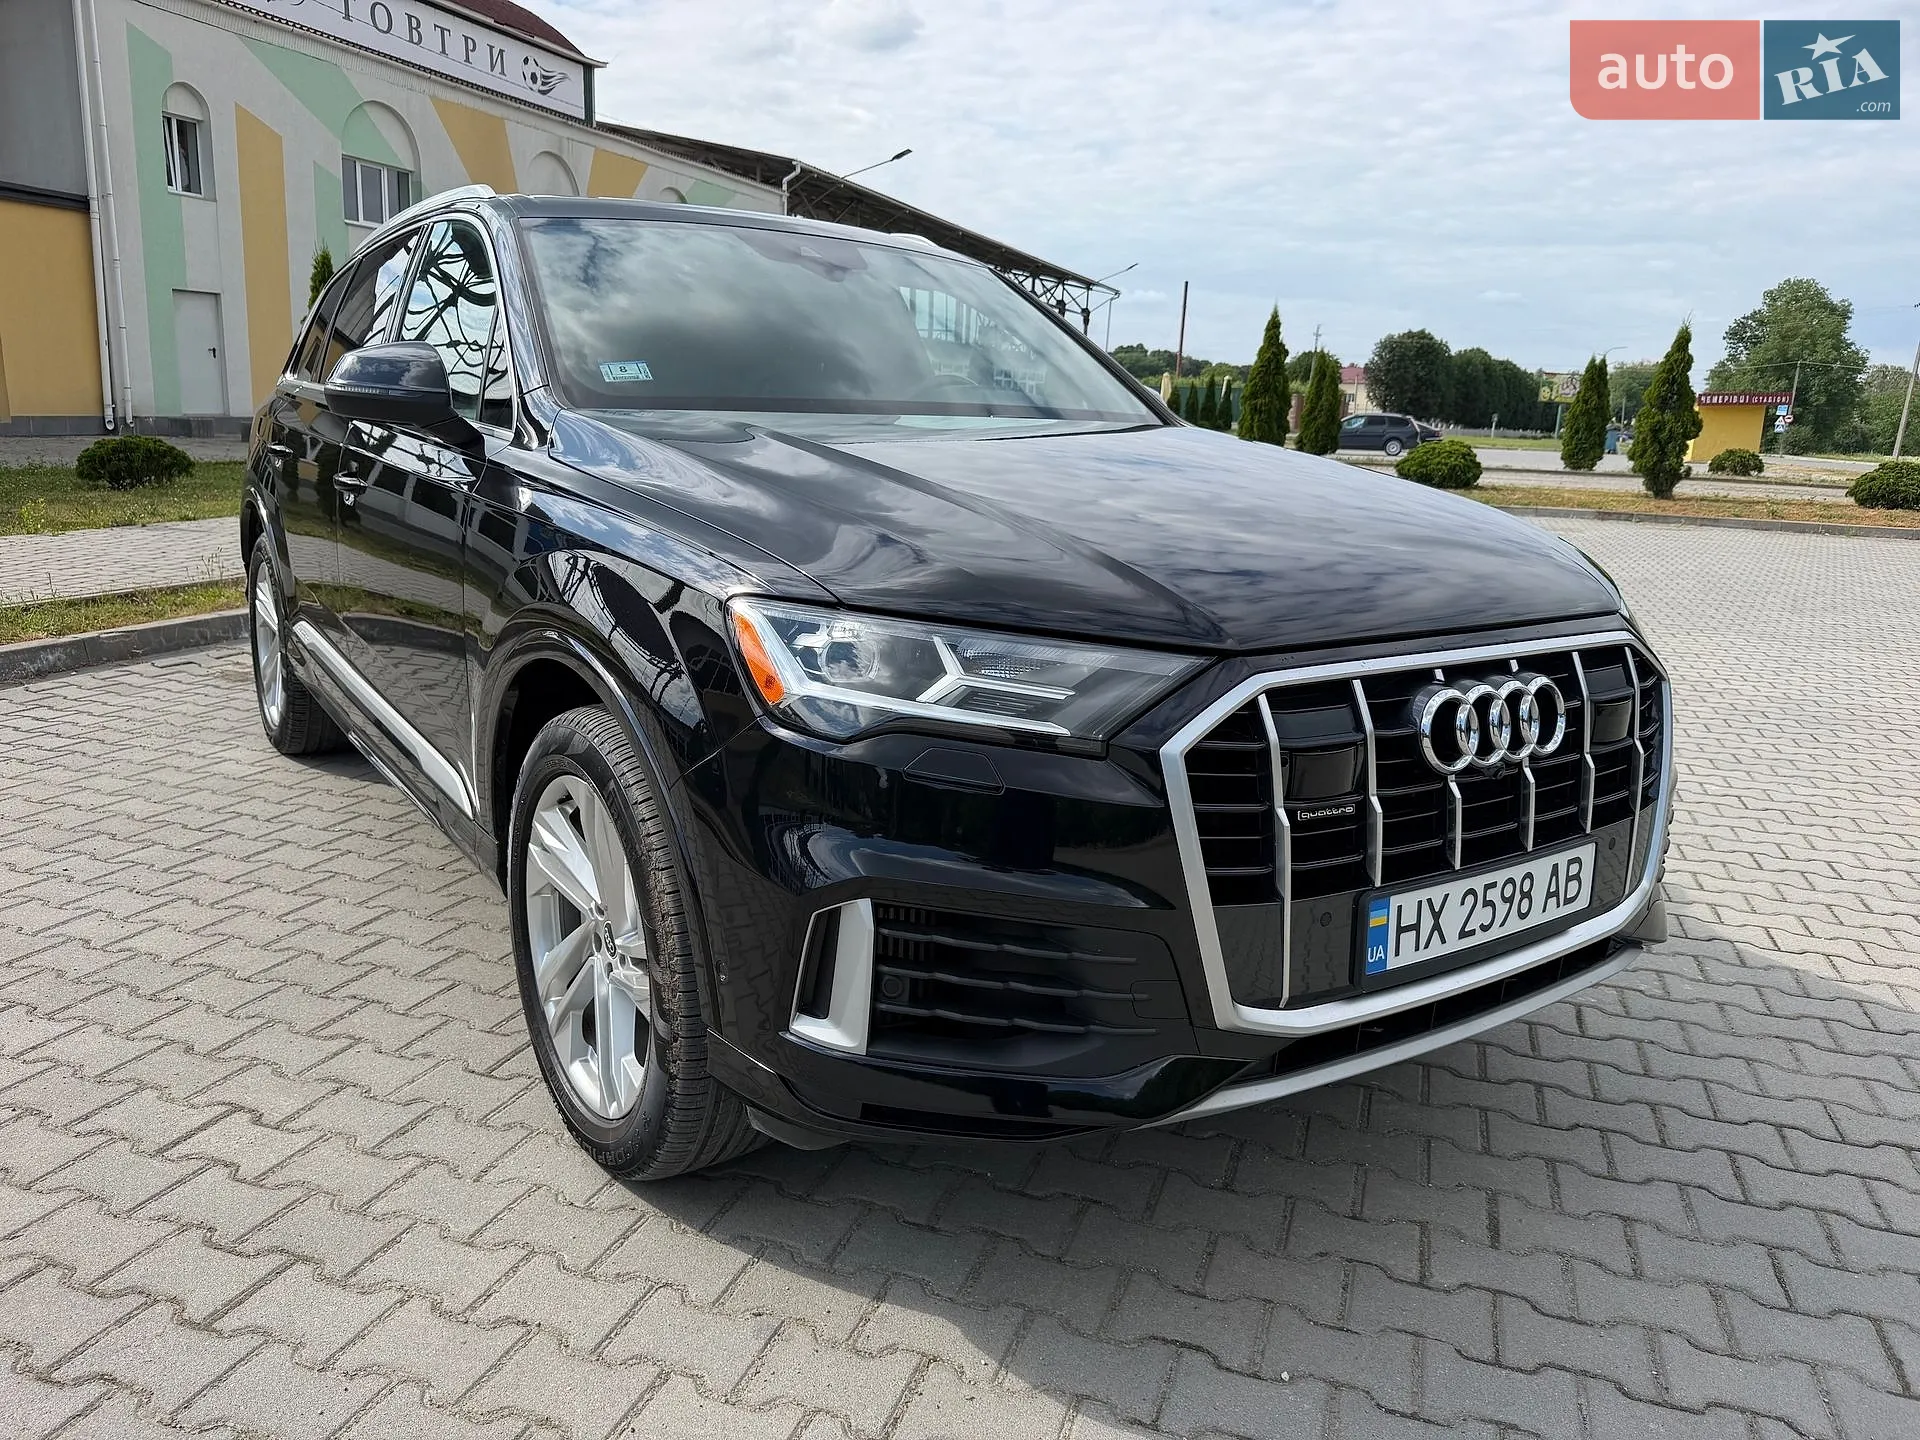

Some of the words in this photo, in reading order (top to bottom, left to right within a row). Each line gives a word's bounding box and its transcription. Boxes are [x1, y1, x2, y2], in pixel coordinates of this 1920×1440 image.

[619, 365, 628, 373] 8
[1300, 806, 1354, 819] quattro
[1394, 892, 1450, 957] HX
[1457, 871, 1535, 940] 2598
[1541, 856, 1584, 914] AB
[1367, 944, 1385, 963] UA
